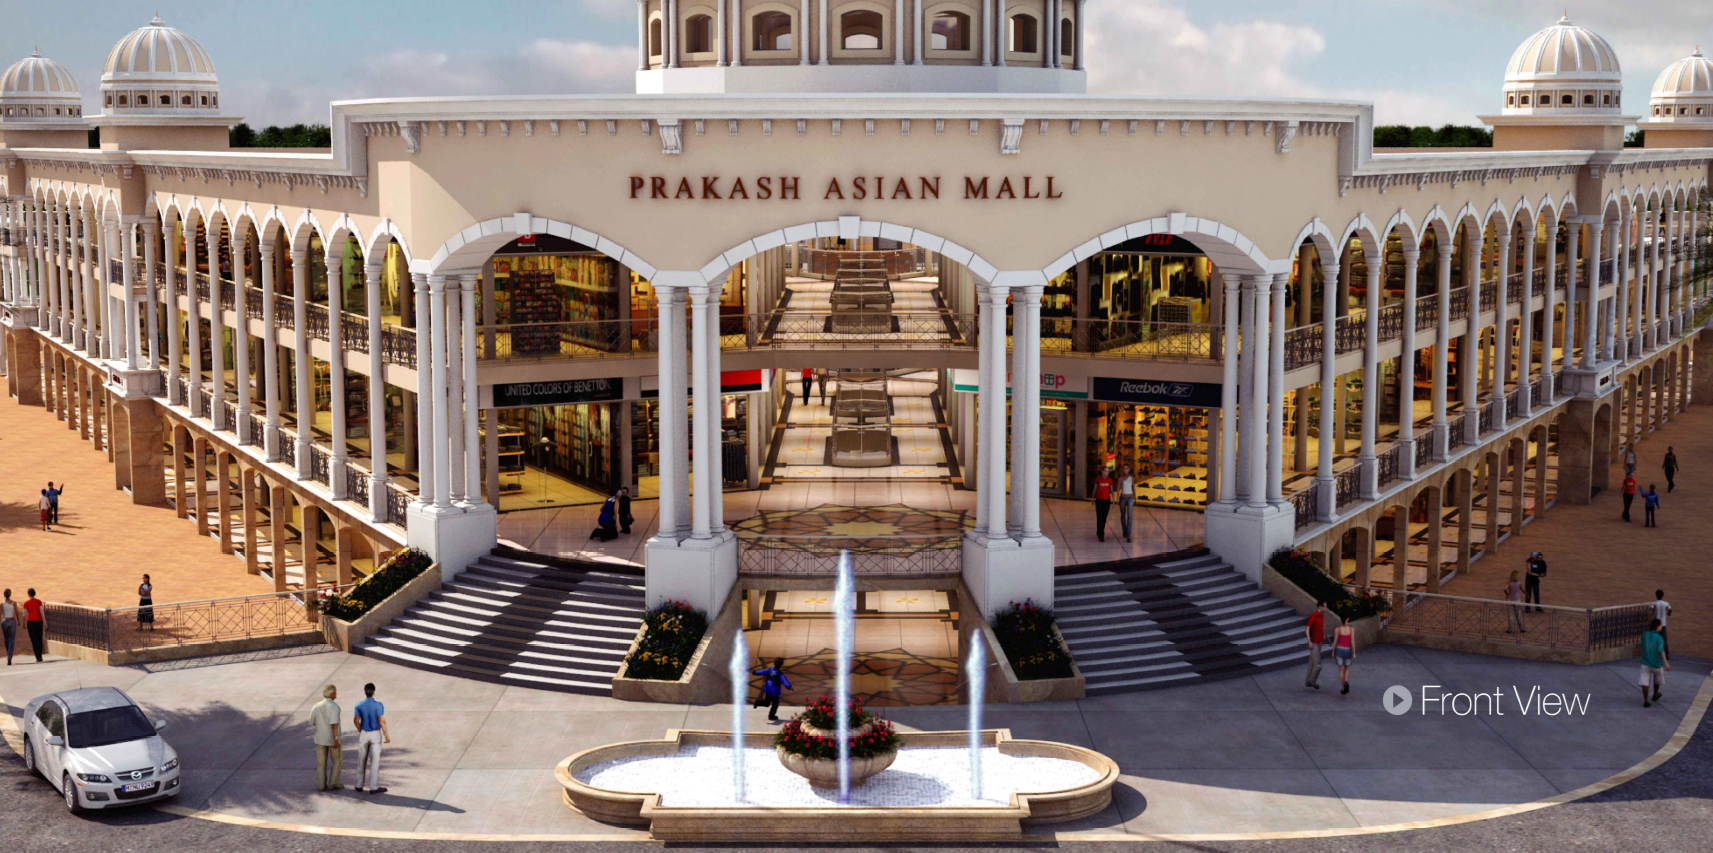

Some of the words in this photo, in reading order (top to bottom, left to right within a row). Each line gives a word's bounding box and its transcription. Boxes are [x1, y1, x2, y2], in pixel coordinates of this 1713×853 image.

[628, 176, 801, 200] PRAKASH
[823, 176, 942, 200] ASIAN
[963, 176, 1064, 200] MALL
[504, 385, 532, 397] UNITED
[533, 382, 562, 395] COLORS
[563, 382, 573, 393] OF
[574, 379, 611, 393] BENETTON
[1121, 382, 1168, 395] Reebok
